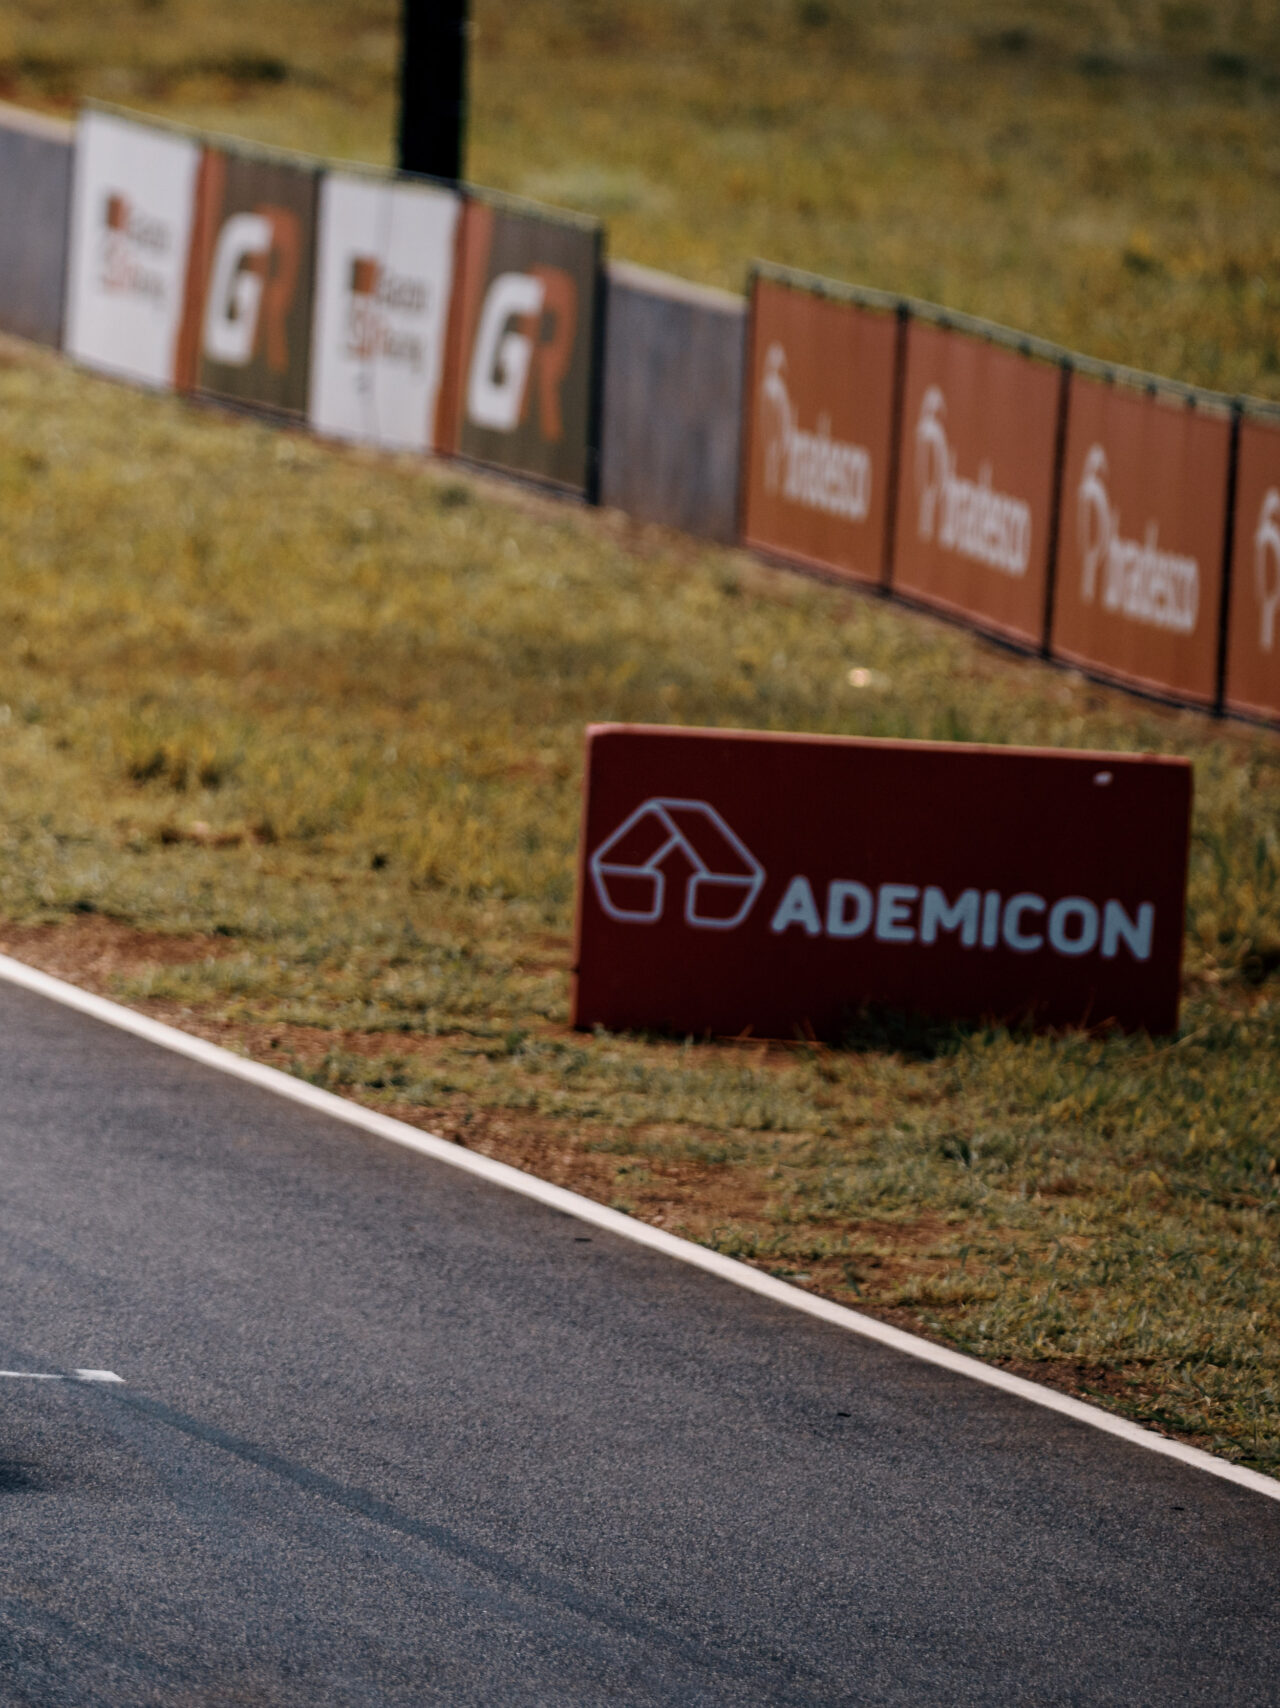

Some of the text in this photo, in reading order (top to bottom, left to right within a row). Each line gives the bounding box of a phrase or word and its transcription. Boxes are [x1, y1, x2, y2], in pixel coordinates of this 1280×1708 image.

[204, 204, 301, 374] GR
[468, 263, 578, 442] GR
[770, 875, 1156, 961] ADEMICON
